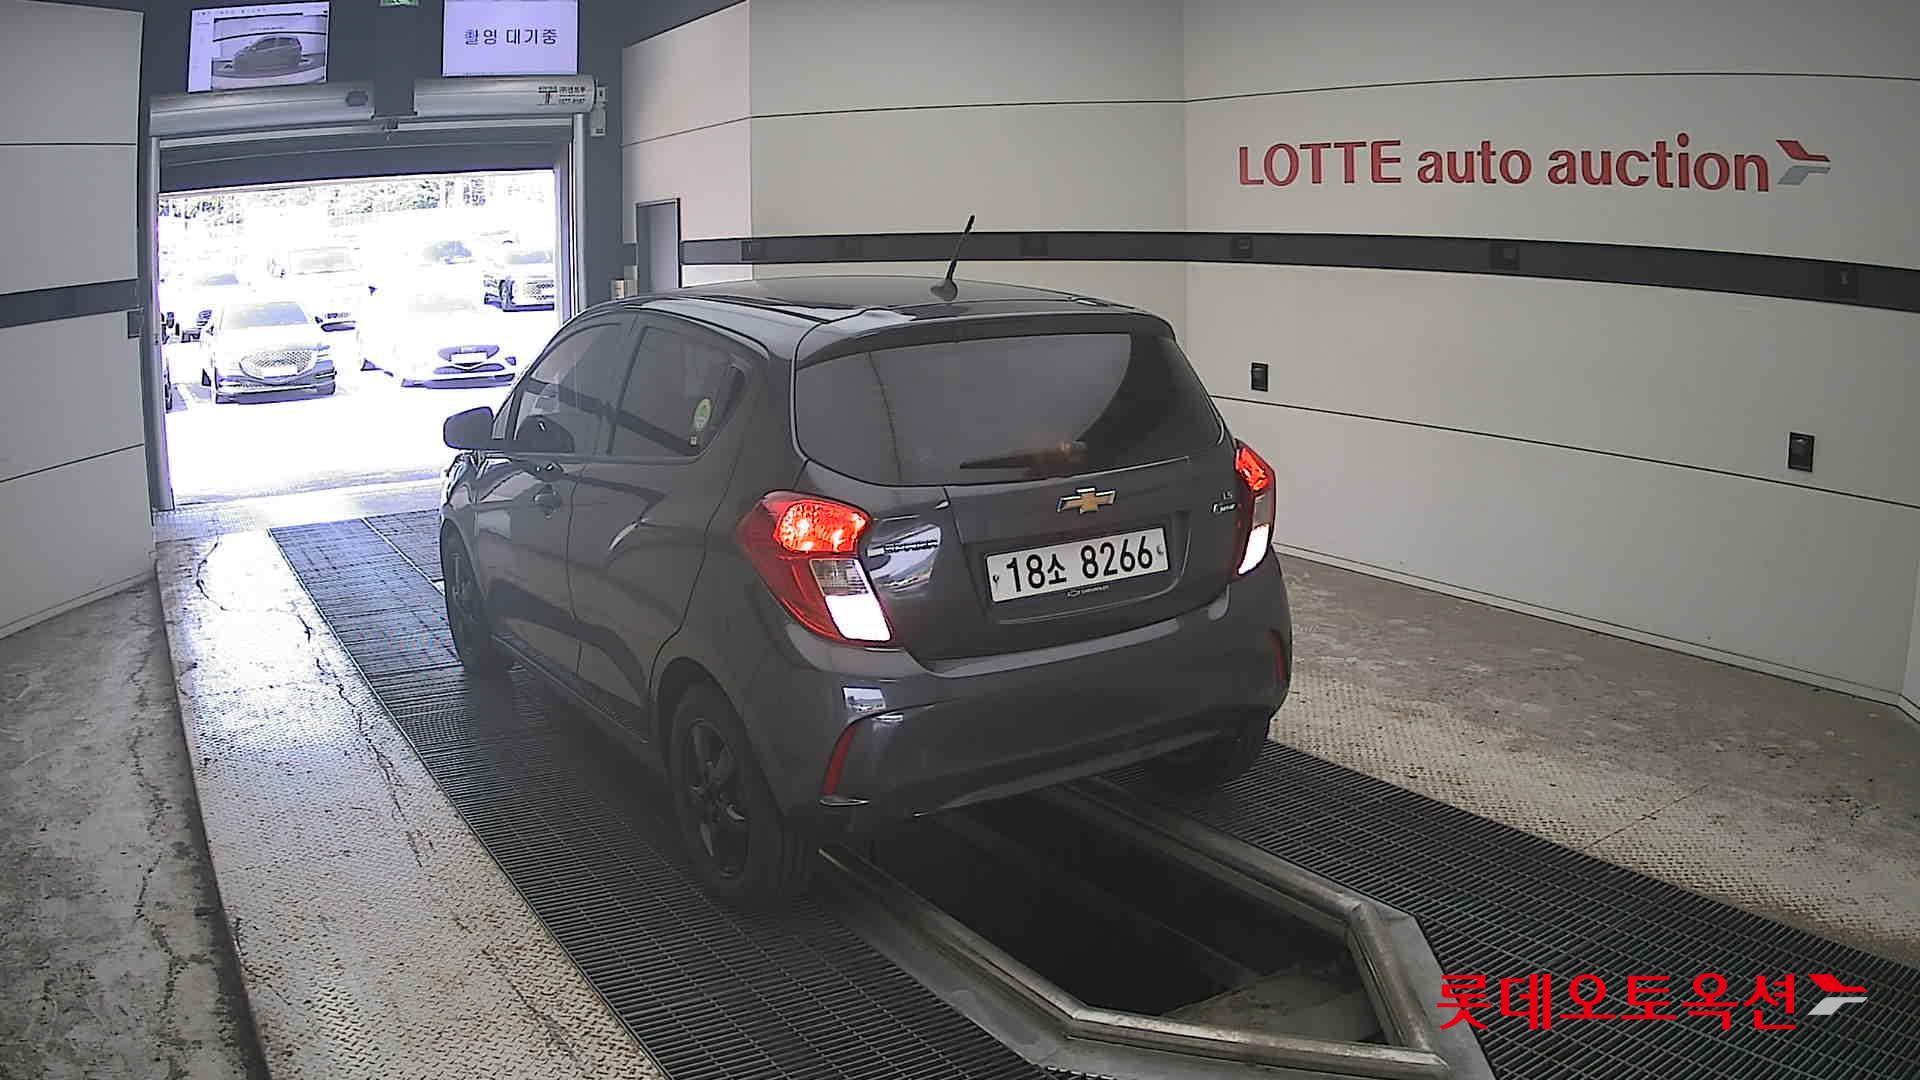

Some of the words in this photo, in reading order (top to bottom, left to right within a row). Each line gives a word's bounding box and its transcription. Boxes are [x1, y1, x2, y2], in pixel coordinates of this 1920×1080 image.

[506, 28, 559, 46] 대기중
[1239, 141, 1399, 184] LOTTE
[1417, 141, 1533, 185] auto
[1548, 133, 1769, 191] auction
[1006, 553, 1068, 593] 18소
[1080, 535, 1154, 580] 8266
